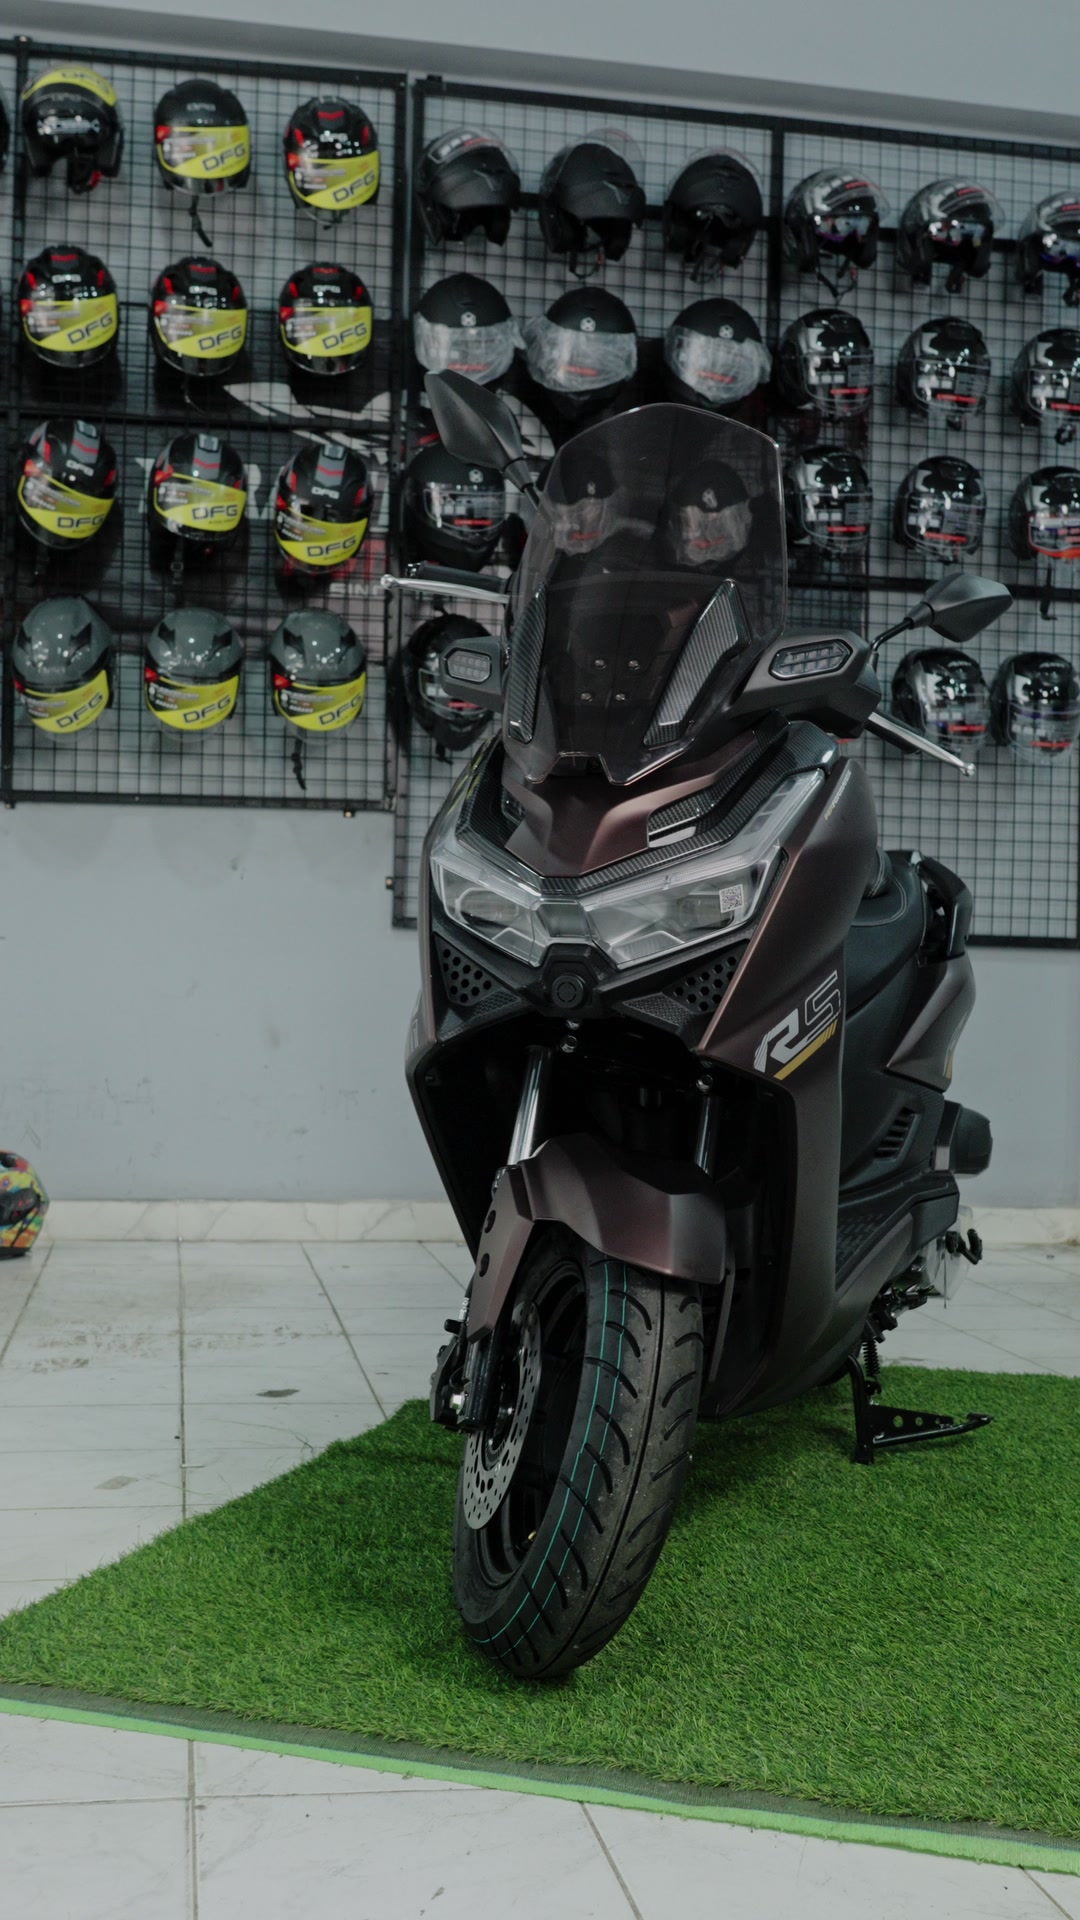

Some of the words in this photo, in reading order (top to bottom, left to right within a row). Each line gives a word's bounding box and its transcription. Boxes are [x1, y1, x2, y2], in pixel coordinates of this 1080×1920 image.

[202, 144, 247, 171] DFG
[332, 171, 376, 202] DFG
[68, 313, 114, 344] DFG
[198, 327, 243, 350] DFG
[322, 323, 368, 349] DFG
[66, 460, 94, 477] DFG
[311, 486, 340, 499] DFG
[57, 513, 105, 529] DFG
[191, 505, 239, 520] DFG
[307, 536, 357, 557] DFG
[56, 693, 104, 728] DFG
[182, 695, 231, 724] DFG
[319, 695, 363, 725] DFG
[753, 969, 841, 1073] RS
